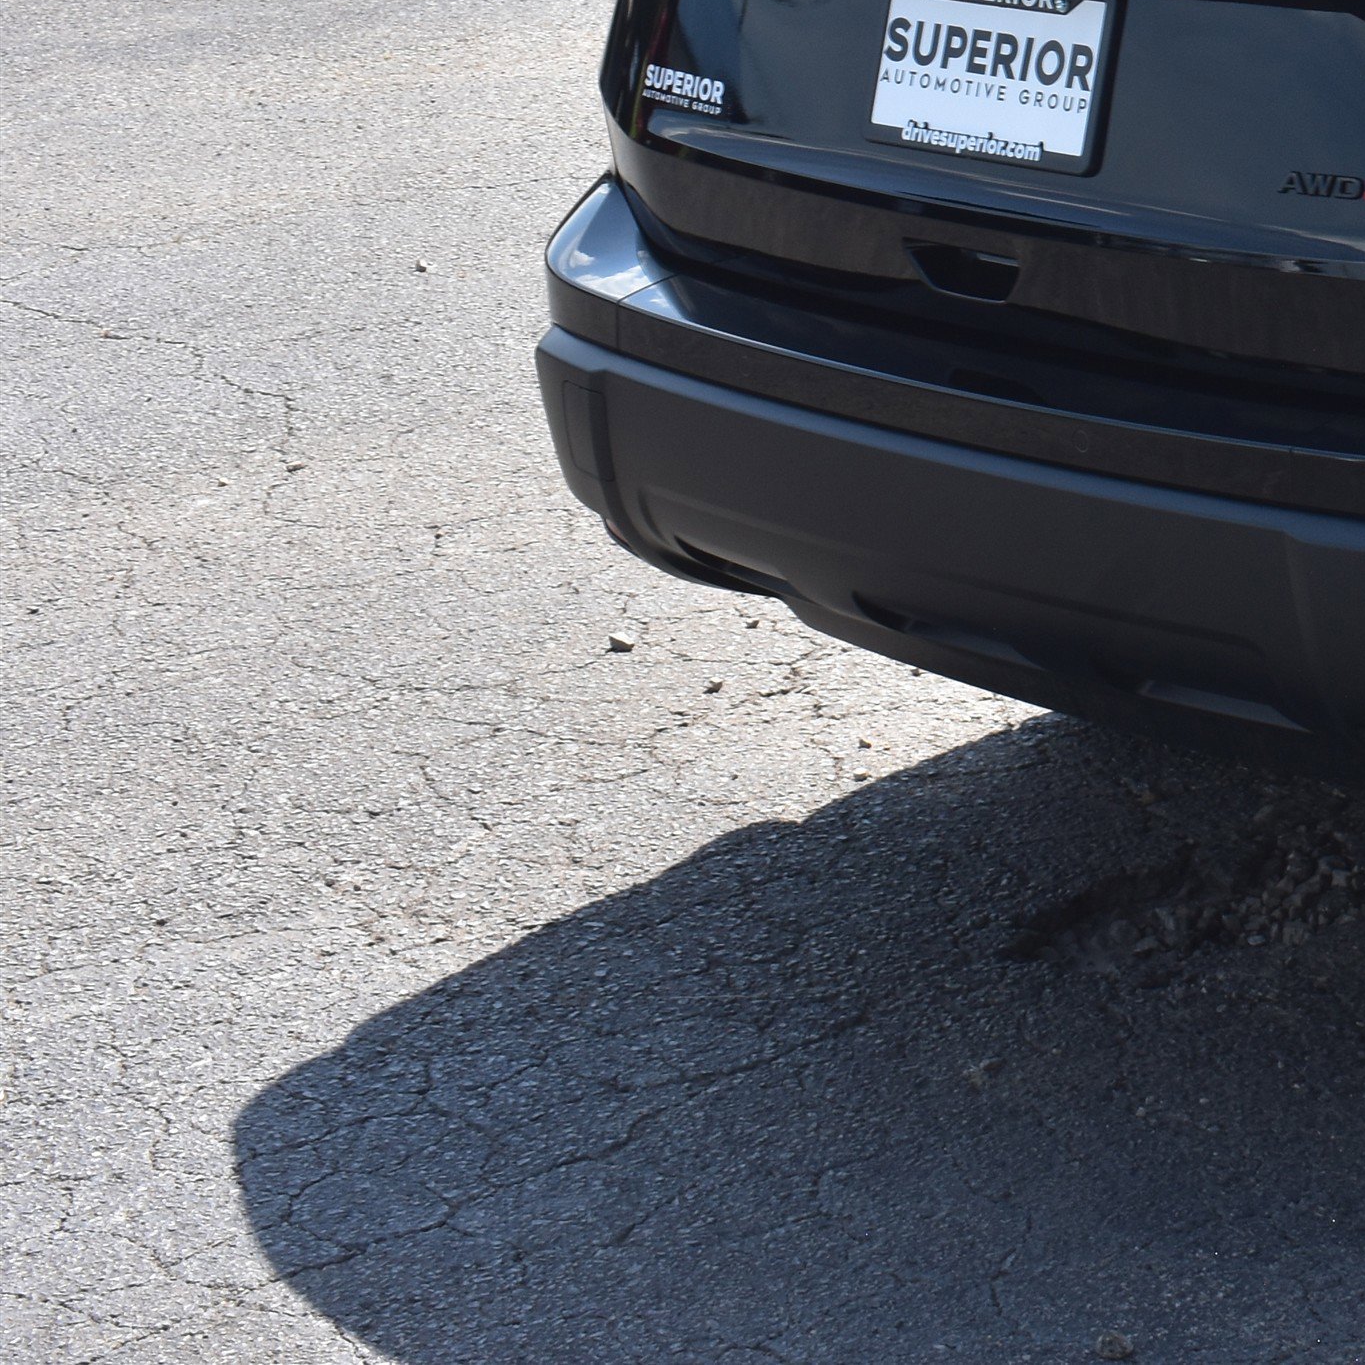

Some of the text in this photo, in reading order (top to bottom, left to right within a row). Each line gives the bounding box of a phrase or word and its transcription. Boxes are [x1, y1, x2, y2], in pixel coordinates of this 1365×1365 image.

[884, 17, 1094, 92] SUPERIOR
[642, 88, 722, 116] AUTOMOTIVE GROUP
[644, 64, 725, 105] SUPERIOR
[880, 68, 1088, 114] AUTOMOTIVE GROUP
[901, 119, 1044, 162] drivesuperior.com
[1277, 170, 1365, 200] AWD
